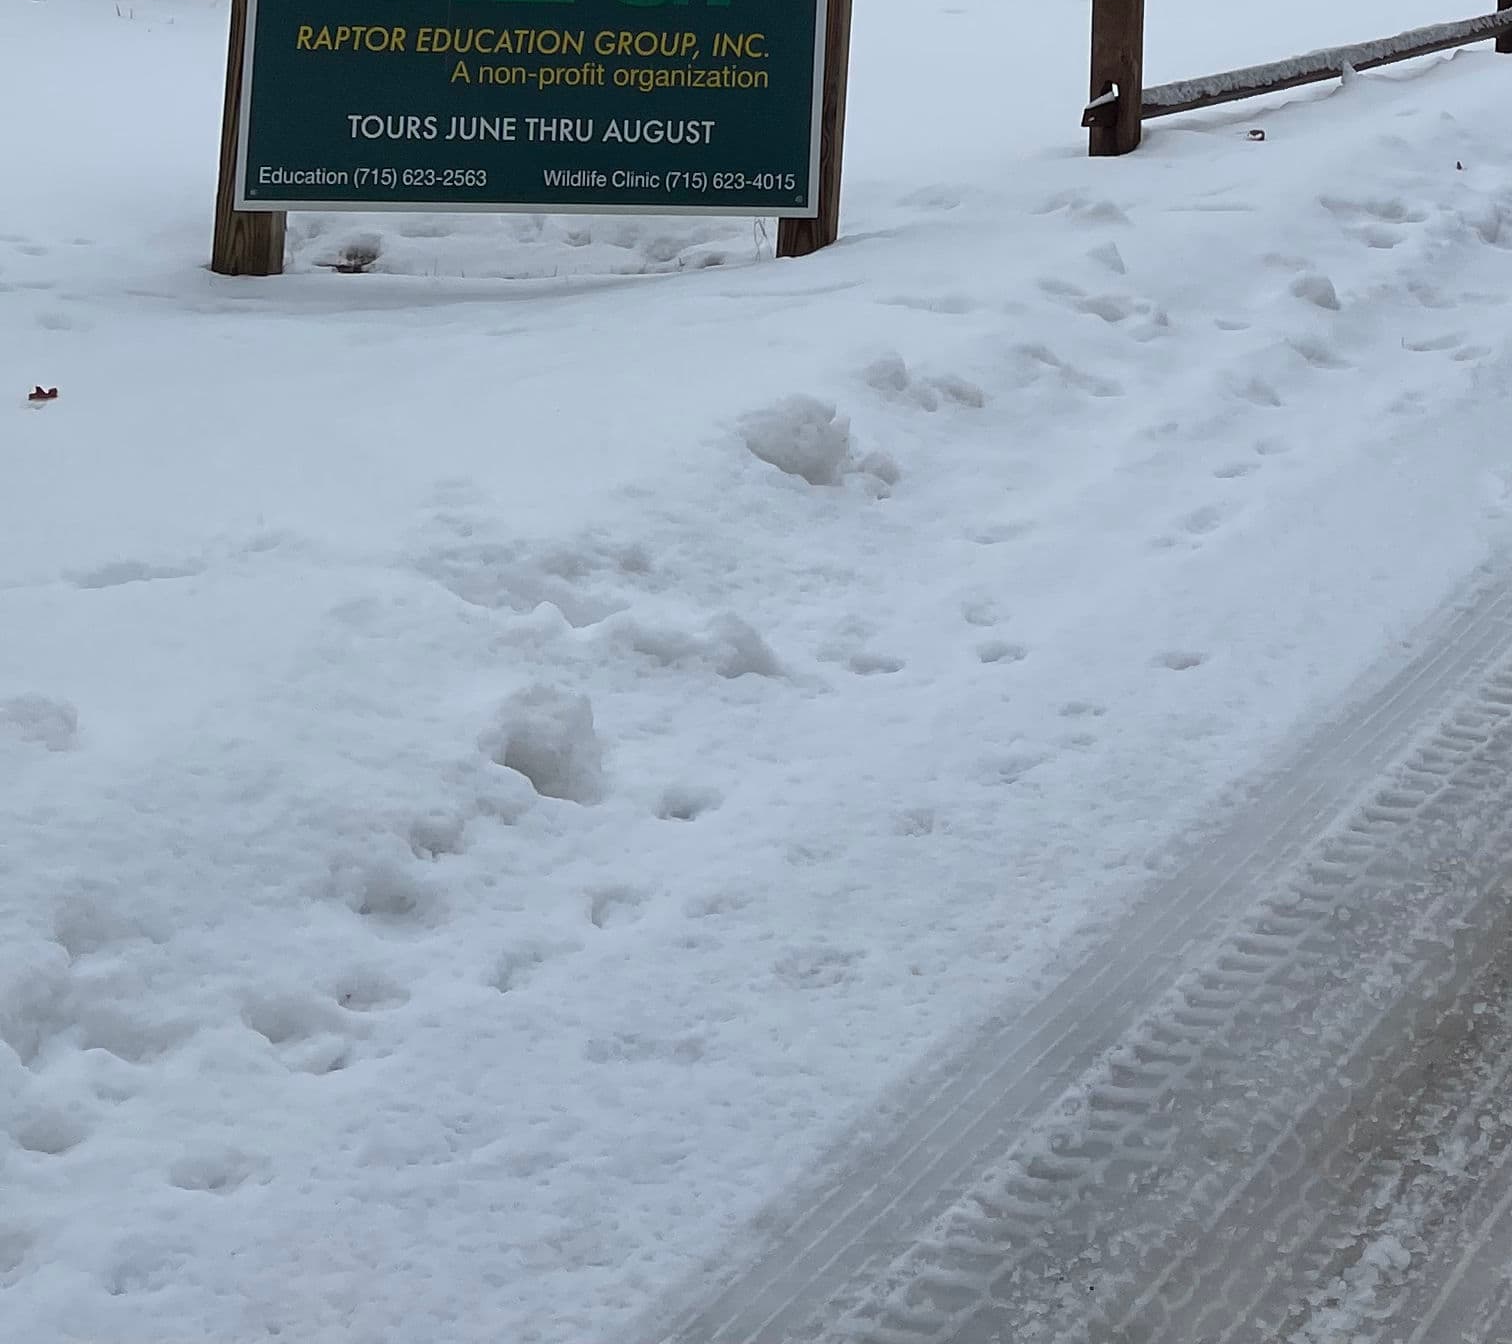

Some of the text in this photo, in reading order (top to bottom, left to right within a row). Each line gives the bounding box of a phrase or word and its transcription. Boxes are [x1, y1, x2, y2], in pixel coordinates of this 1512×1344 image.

[296, 25, 769, 60] RAPTOR EDUCATION GROUP, INC.
[451, 60, 769, 92] A non-profit organization
[347, 115, 715, 144] TOURS JUNE THRU AUGUST
[258, 166, 487, 189] Education (715) 623-2563
[543, 169, 796, 193] Wildlife Clinic (715) 623-4015
